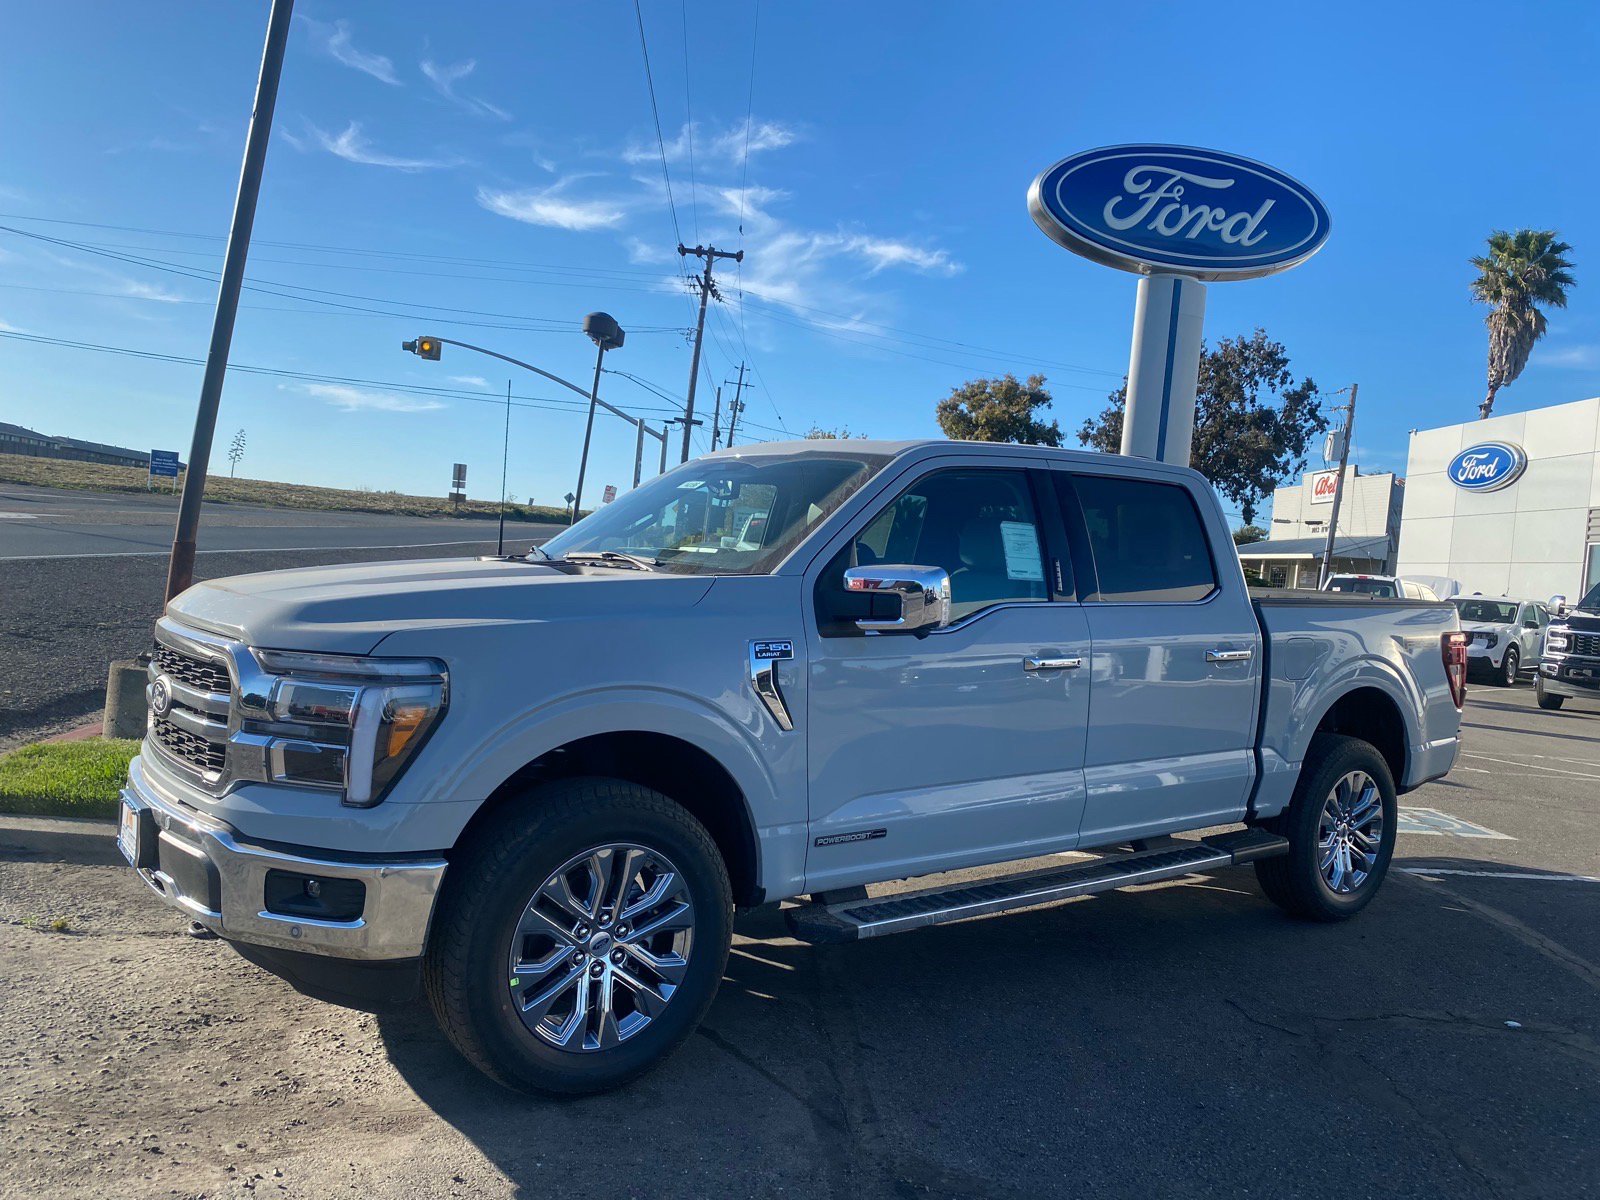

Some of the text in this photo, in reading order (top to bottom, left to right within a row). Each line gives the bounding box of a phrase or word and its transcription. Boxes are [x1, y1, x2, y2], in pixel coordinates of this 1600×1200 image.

[1103, 165, 1277, 247] Ford
[1458, 452, 1499, 481] Ford
[755, 643, 791, 651] F-150
[817, 832, 872, 845] POWERBOOST
